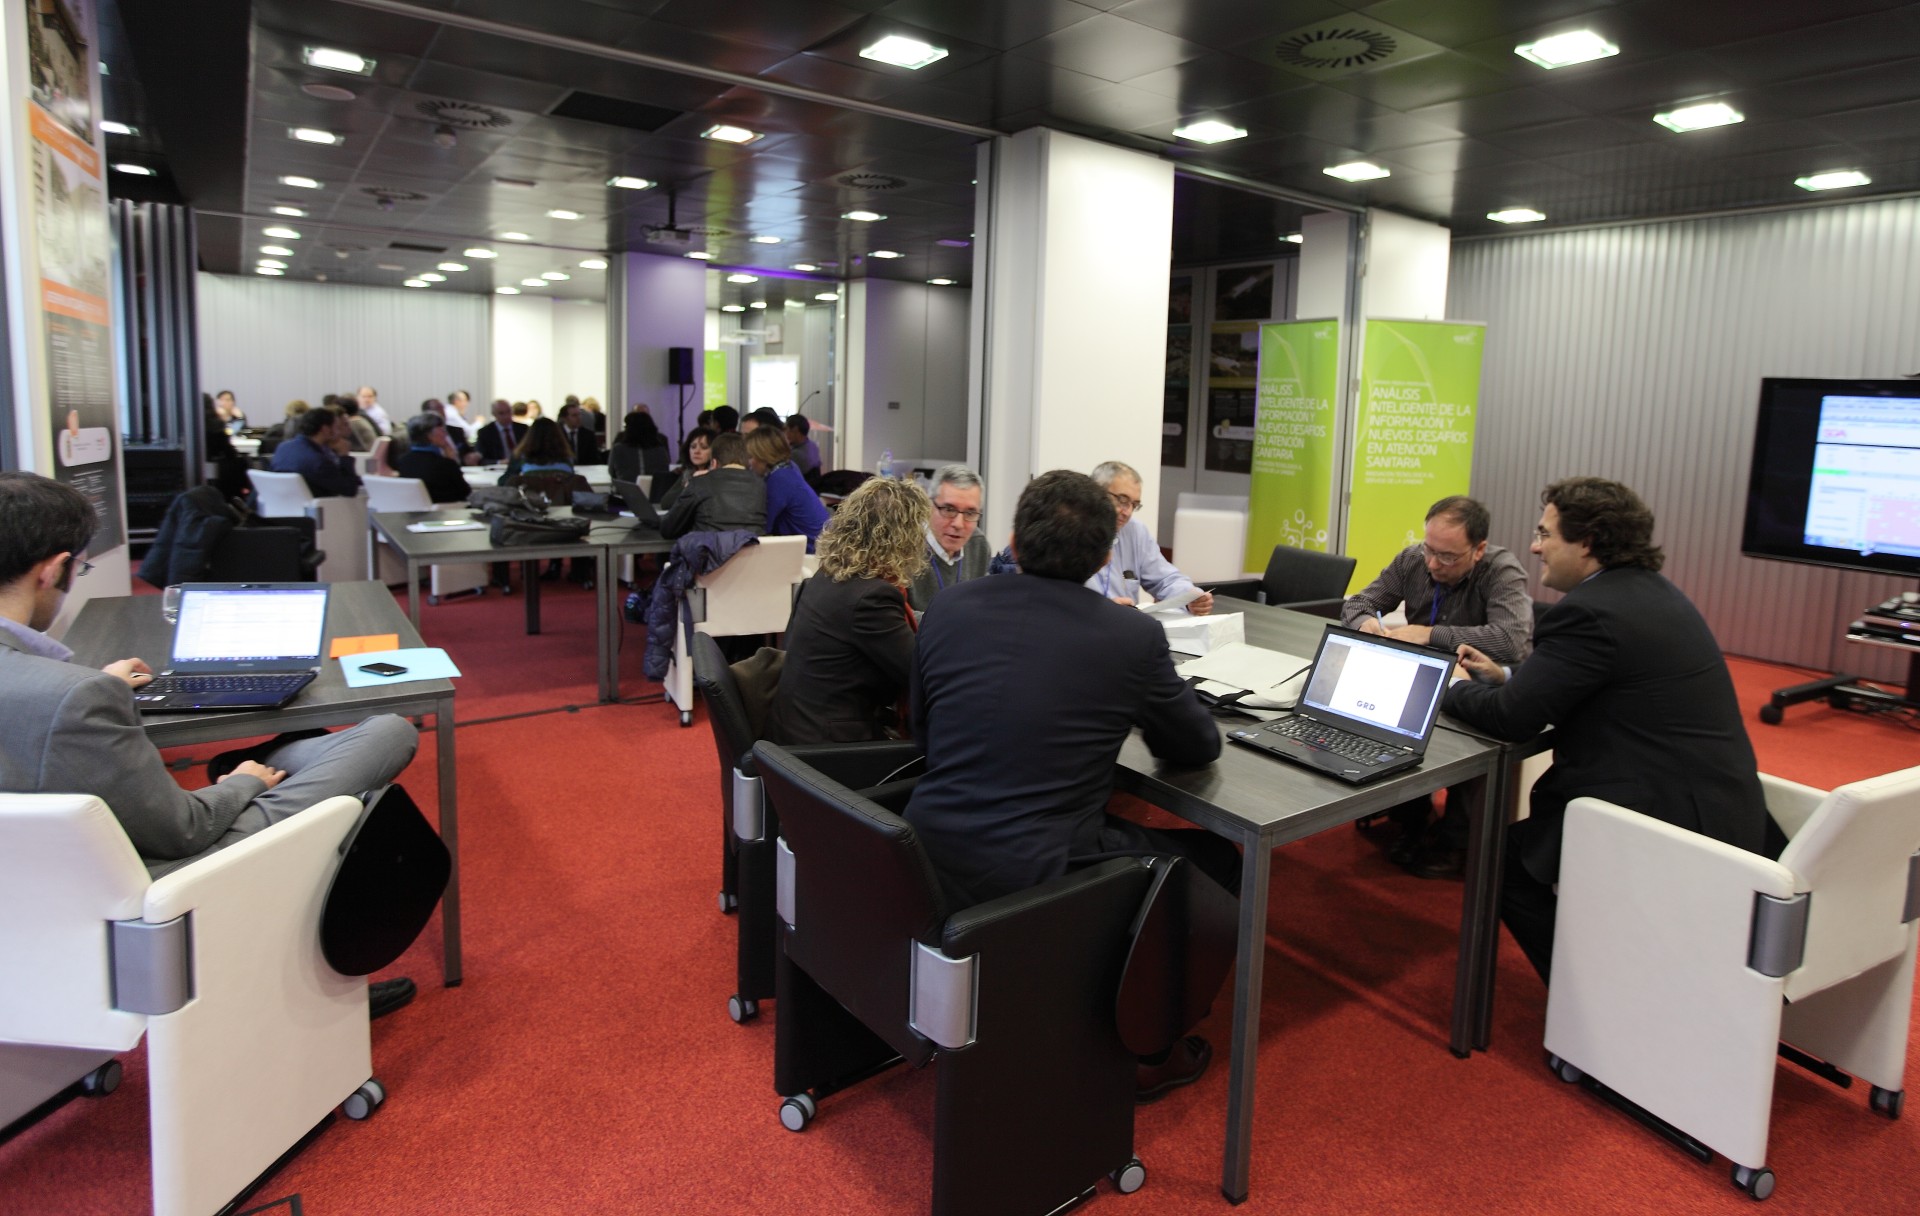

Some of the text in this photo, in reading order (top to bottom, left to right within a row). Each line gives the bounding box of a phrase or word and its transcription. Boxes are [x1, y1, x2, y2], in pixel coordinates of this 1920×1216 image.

[1373, 387, 1420, 400] ANÁLISIS
[1316, 399, 1328, 410] LA
[1371, 401, 1471, 416] INTELIGENTE DE LA
[1370, 415, 1455, 428] INFORMACIÓN Y
[1368, 429, 1413, 441] NUEVOS
[1367, 442, 1437, 456] EN ATENCIÓN
[1365, 456, 1420, 468] SANITARIA
[1356, 700, 1376, 711] GRD
